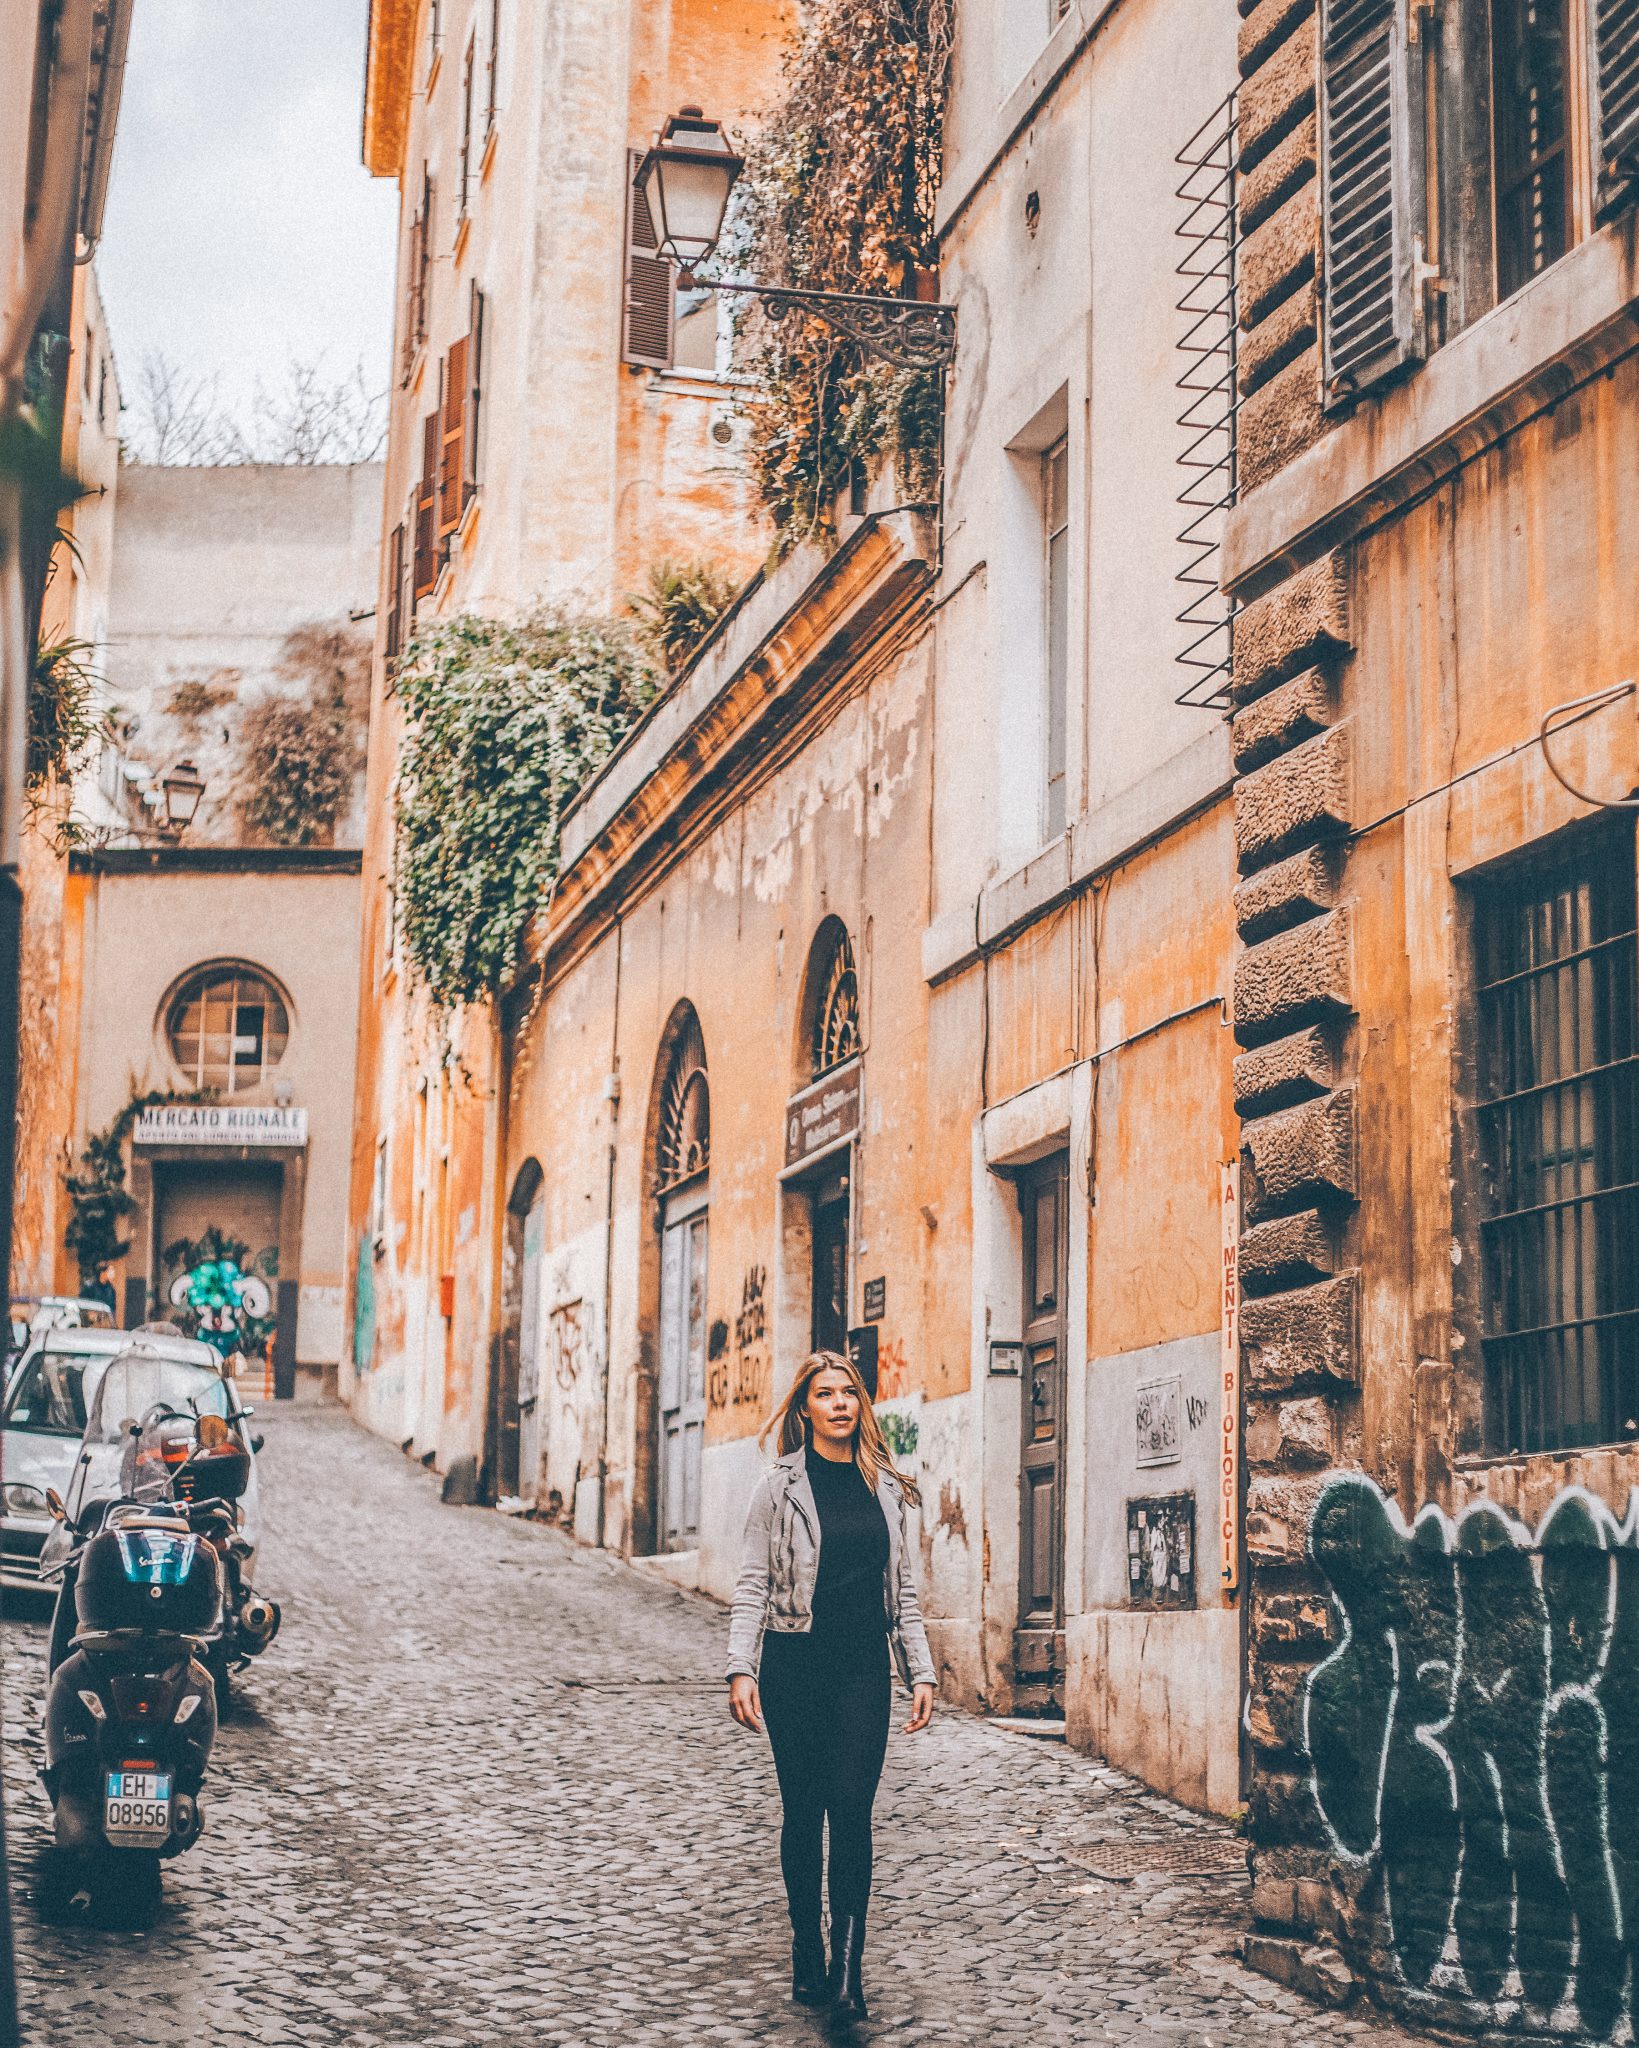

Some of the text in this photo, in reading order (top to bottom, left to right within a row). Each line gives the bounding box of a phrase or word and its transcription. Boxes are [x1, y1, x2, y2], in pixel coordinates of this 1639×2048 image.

[139, 1108, 300, 1128] MERCATO RIONALE
[1222, 1372, 1234, 1561] BIOLOGICI
[123, 1775, 146, 1796] EH
[109, 1803, 166, 1826] 08956
